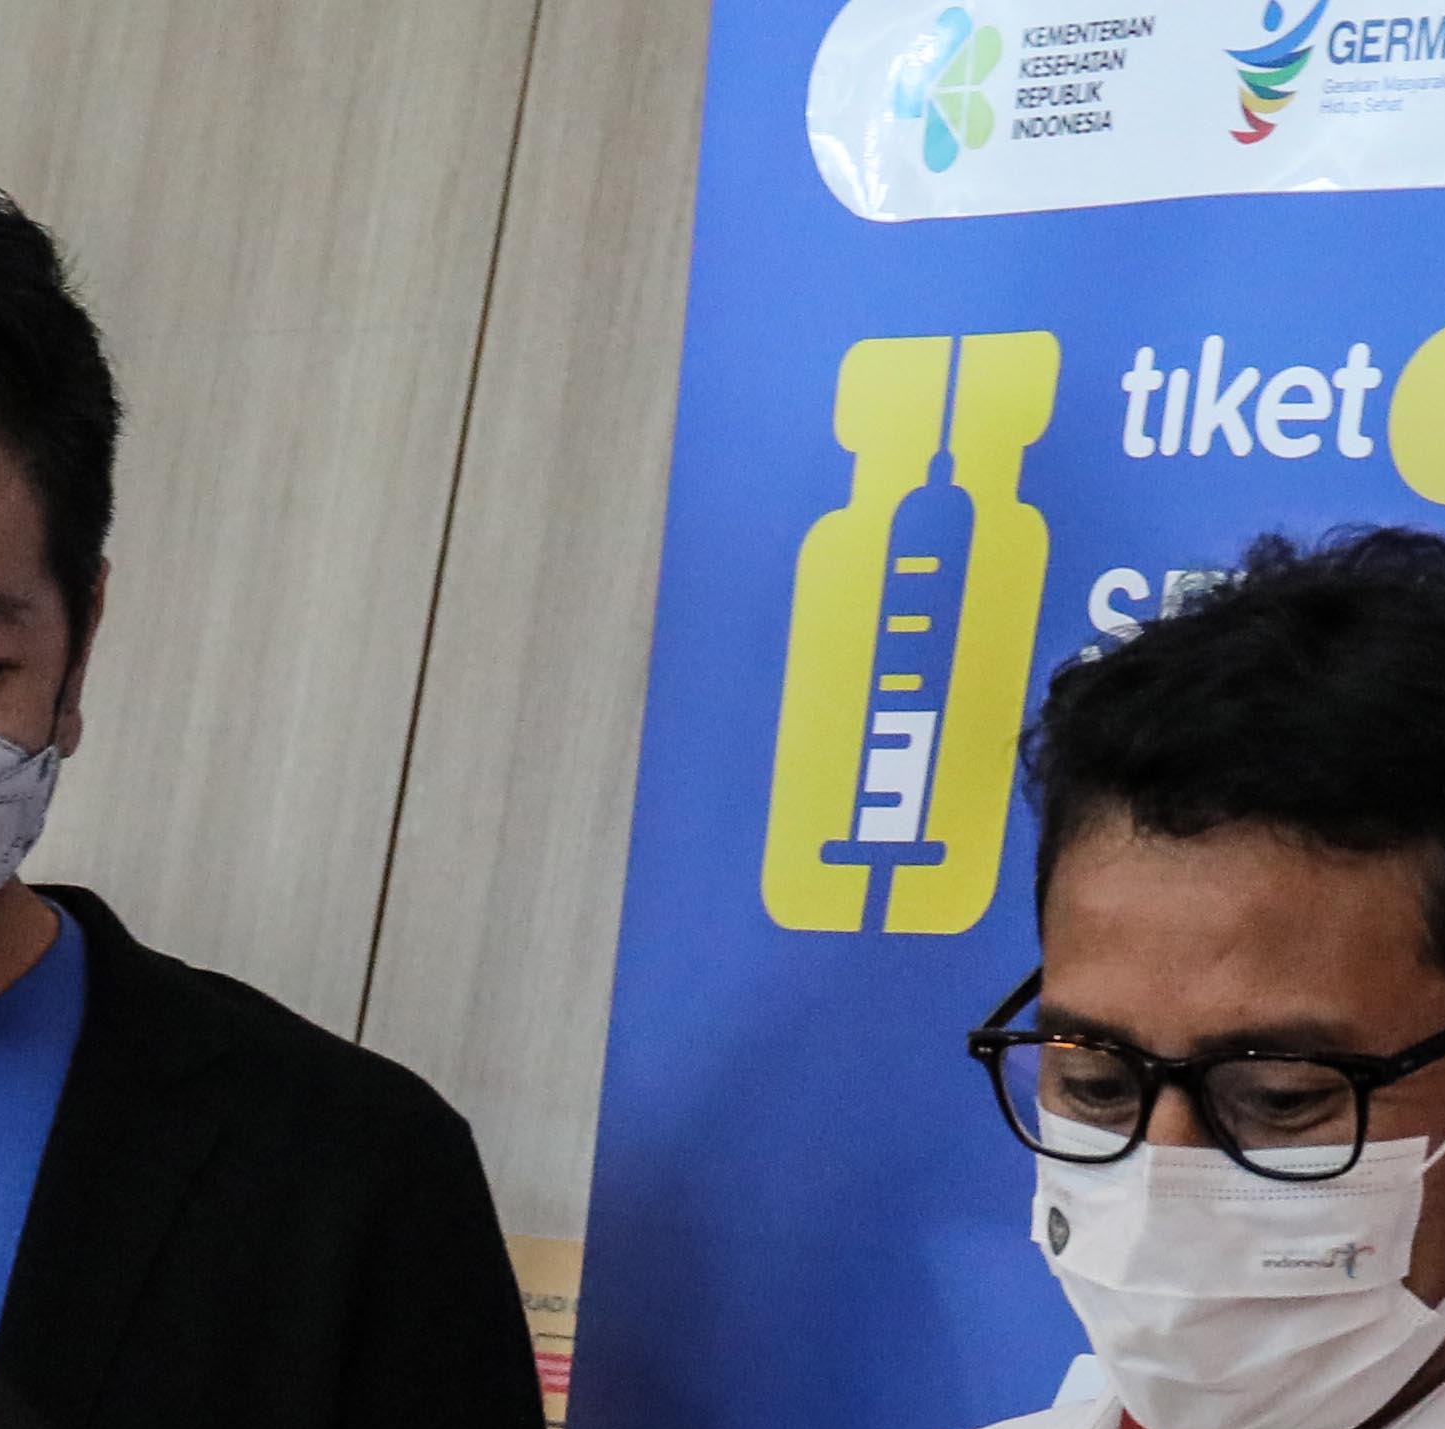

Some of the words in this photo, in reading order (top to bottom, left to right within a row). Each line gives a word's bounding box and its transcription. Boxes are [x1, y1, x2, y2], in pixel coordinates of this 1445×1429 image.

[1021, 16, 1156, 48] KEMENTERIAN
[1019, 48, 1127, 78] KESEHATAN
[1015, 81, 1105, 109] REPUBLIK
[1012, 110, 1113, 139] INDONESIA
